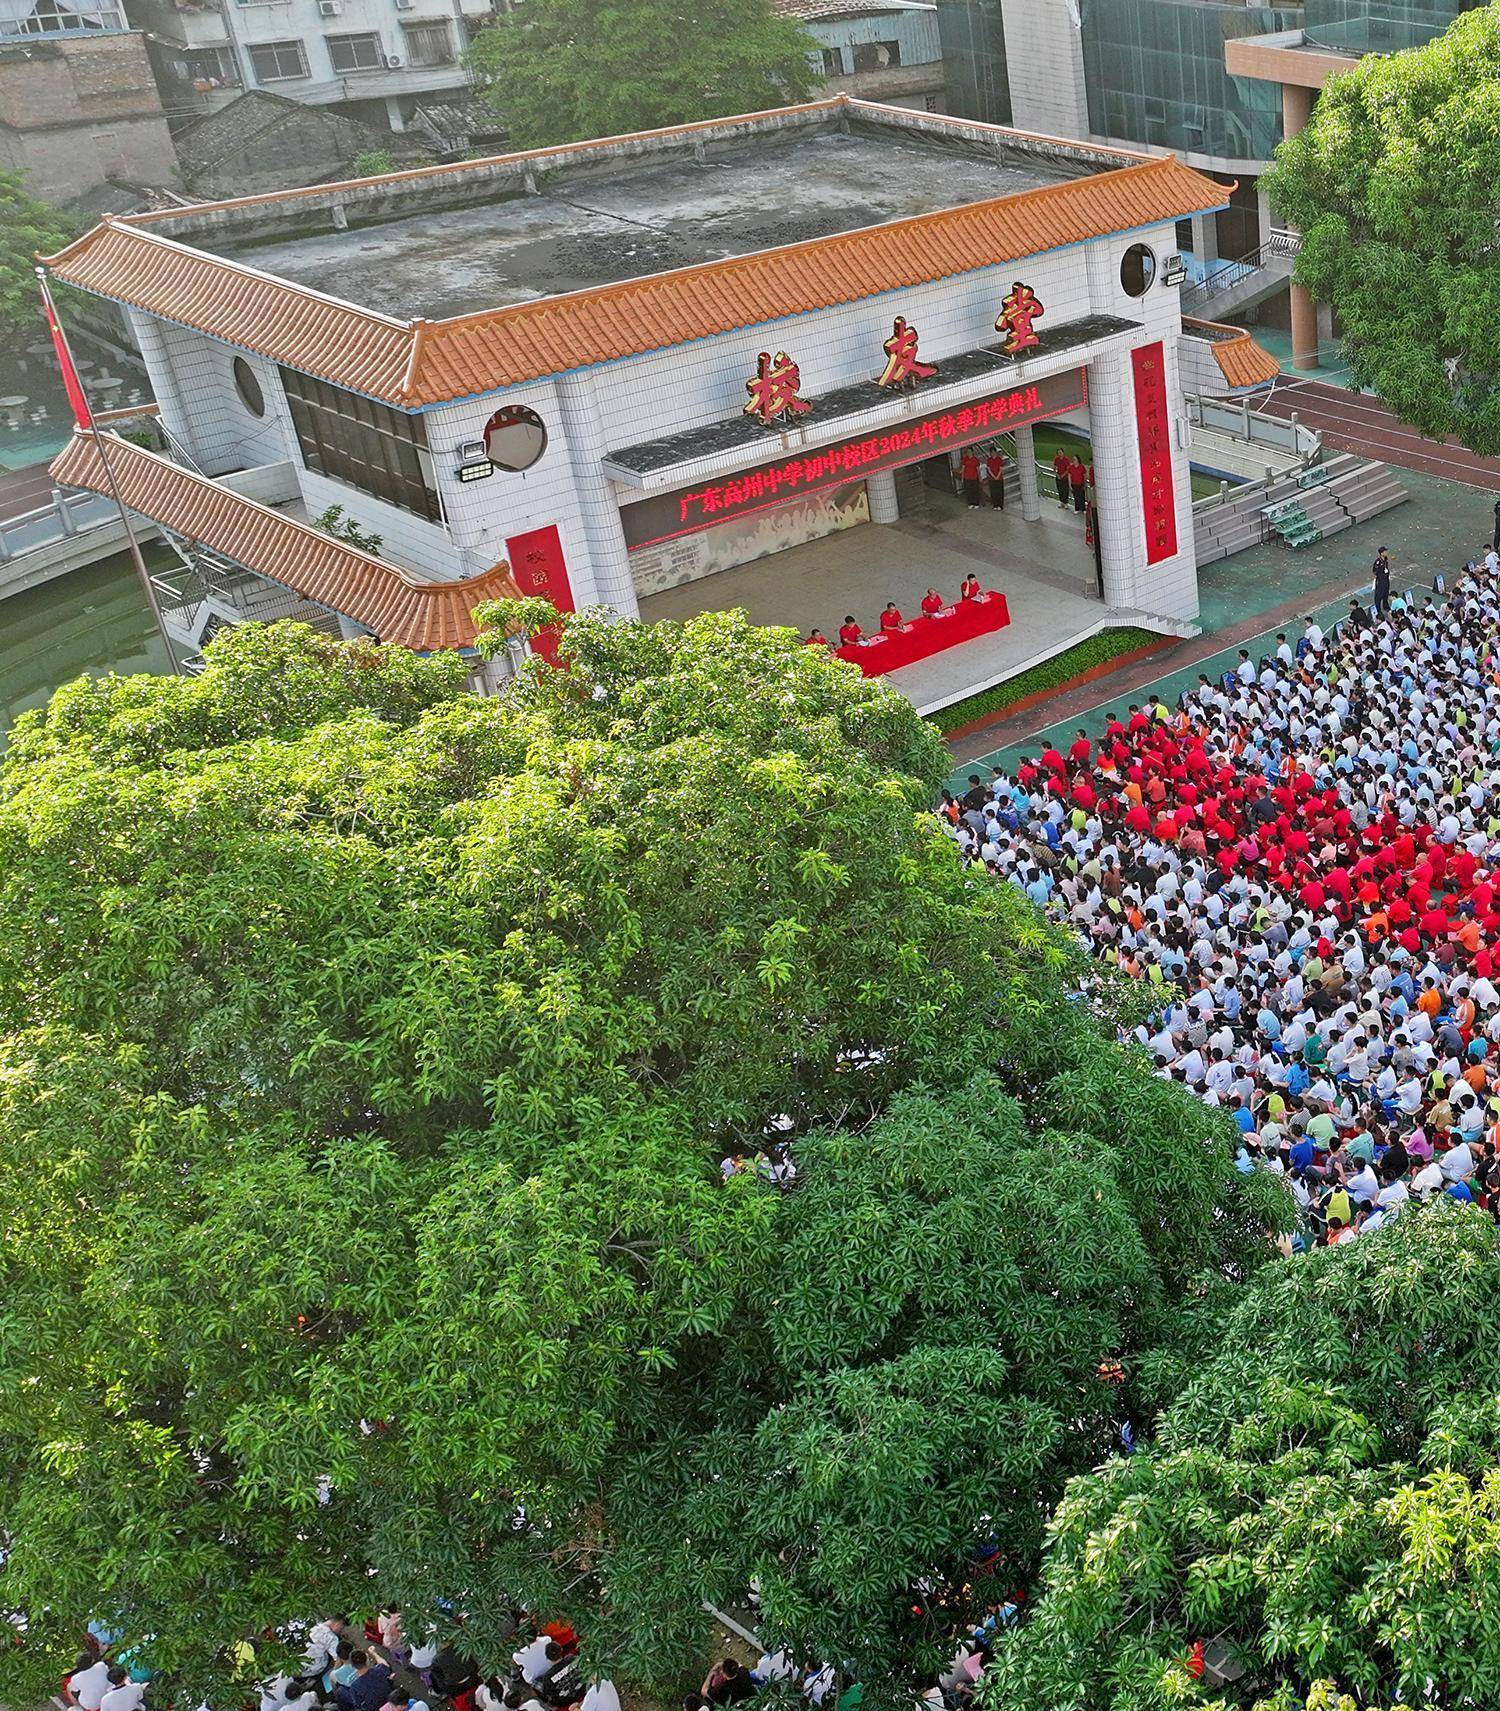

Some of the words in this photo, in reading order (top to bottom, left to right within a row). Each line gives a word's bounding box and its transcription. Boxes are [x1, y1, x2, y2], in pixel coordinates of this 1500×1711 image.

[743, 281, 1045, 426] 校友堂
[680, 386, 1044, 522] 广东高州中学初中校区2024年秋季开学典礼
